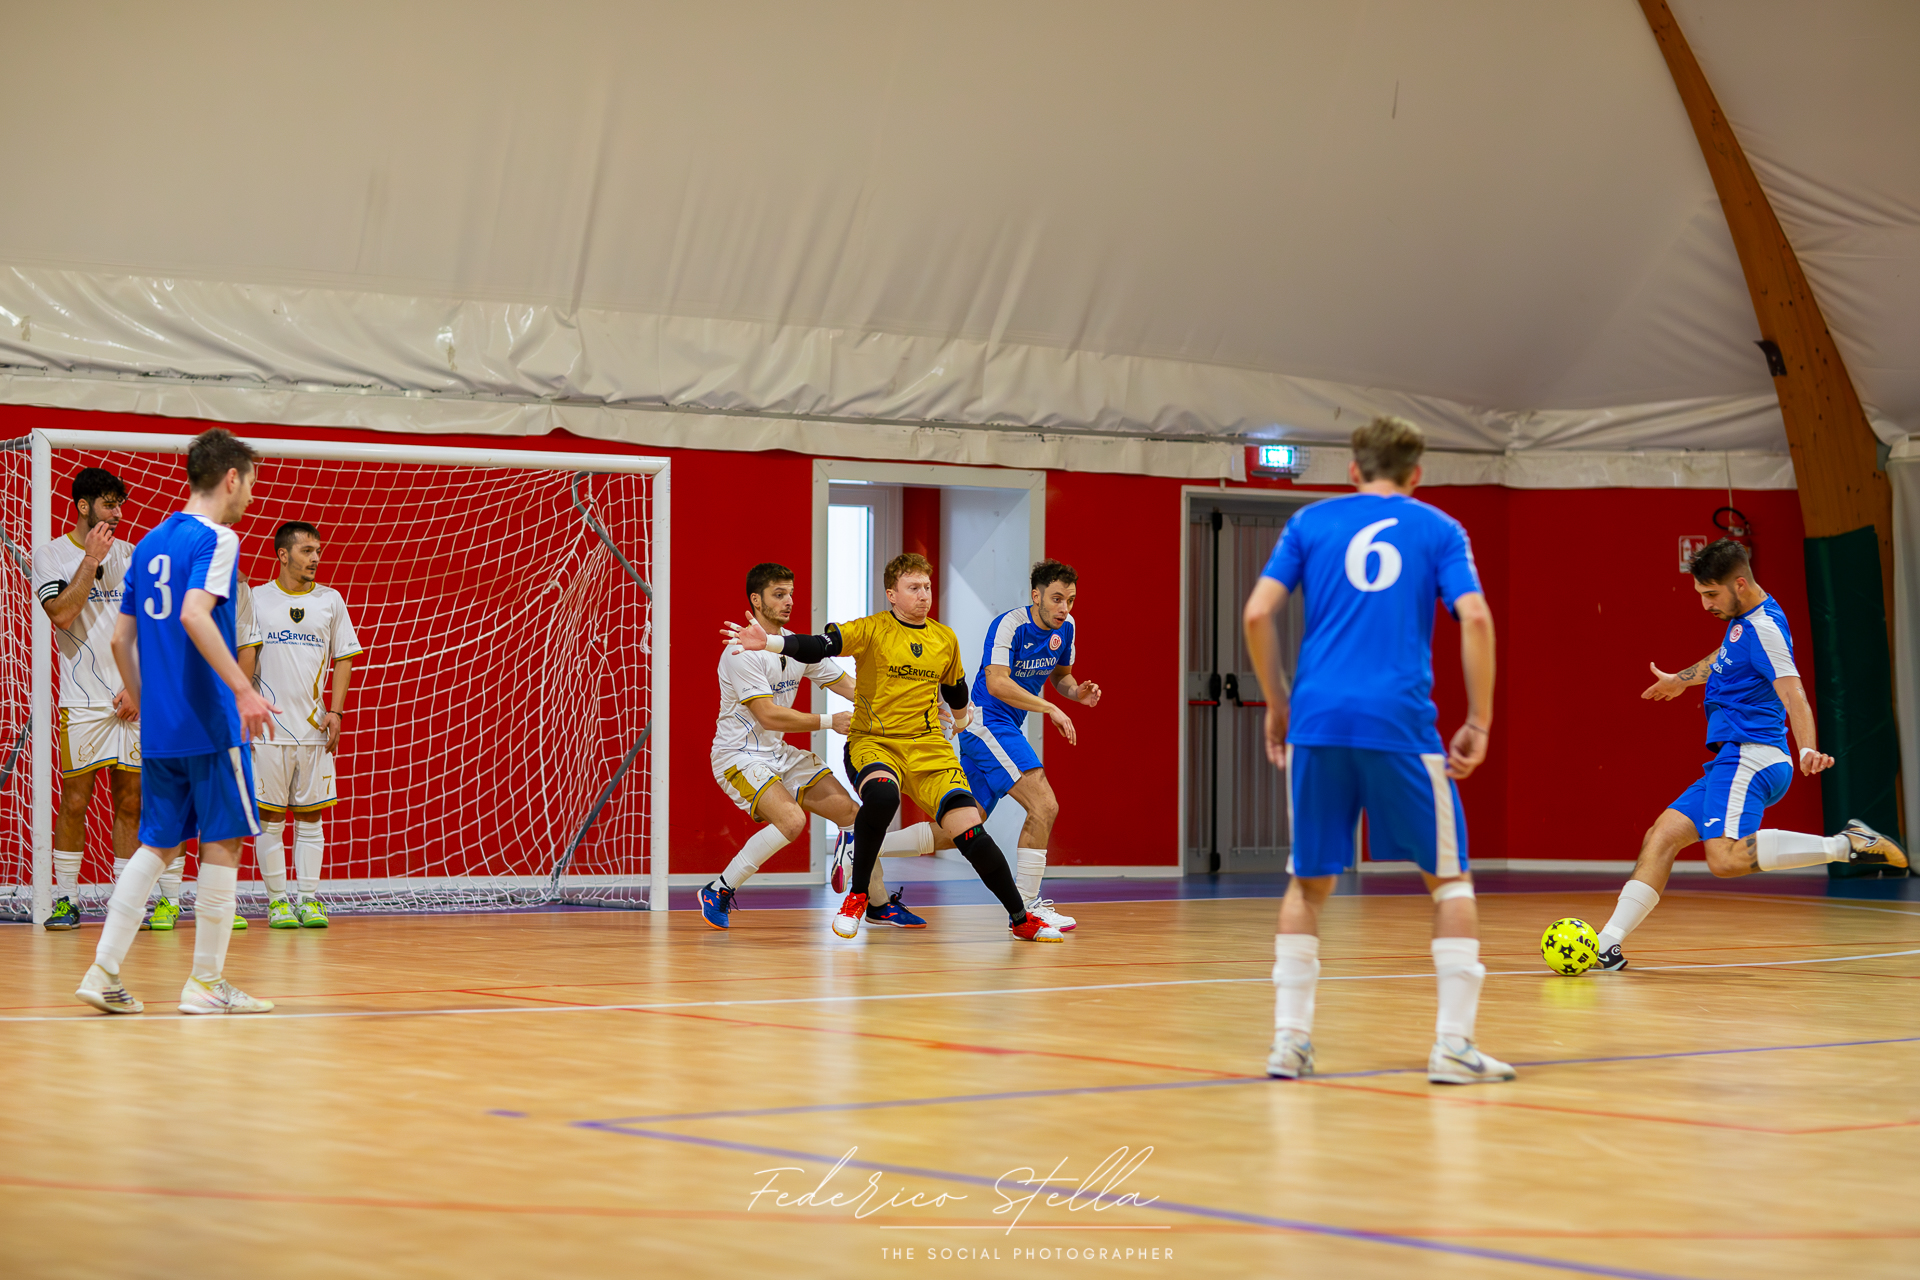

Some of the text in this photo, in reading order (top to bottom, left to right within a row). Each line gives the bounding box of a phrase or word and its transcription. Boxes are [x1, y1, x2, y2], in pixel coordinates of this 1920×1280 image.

[1344, 517, 1403, 592] 6
[144, 554, 171, 620] 3
[129, 742, 142, 761] 8
[322, 775, 332, 794] 7
